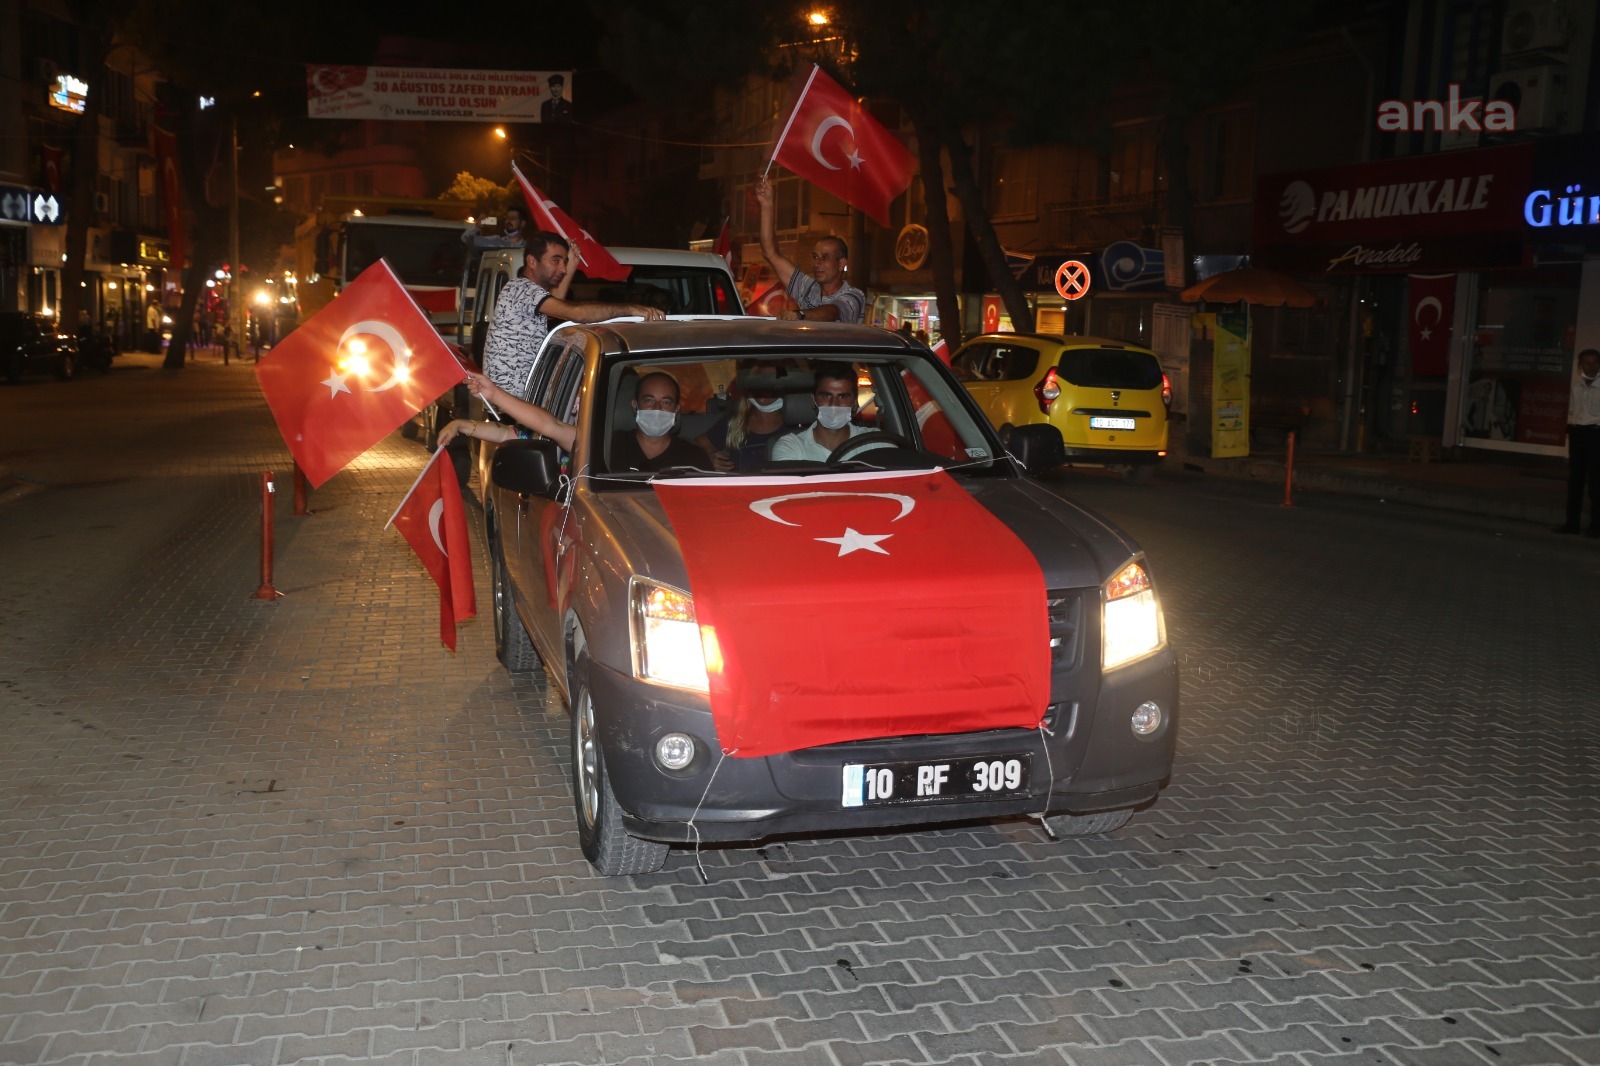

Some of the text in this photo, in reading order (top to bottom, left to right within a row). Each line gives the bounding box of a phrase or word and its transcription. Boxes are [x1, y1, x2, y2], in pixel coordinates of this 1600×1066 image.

[373, 80, 540, 96] 30 AĞUSTOS ZAFER BAYRAMI
[417, 96, 497, 108] KUTLU OLSUN
[1316, 174, 1494, 223] PAMUKKALE
[1326, 242, 1422, 271] Anadolu
[866, 759, 1021, 800] 10 RF 309
